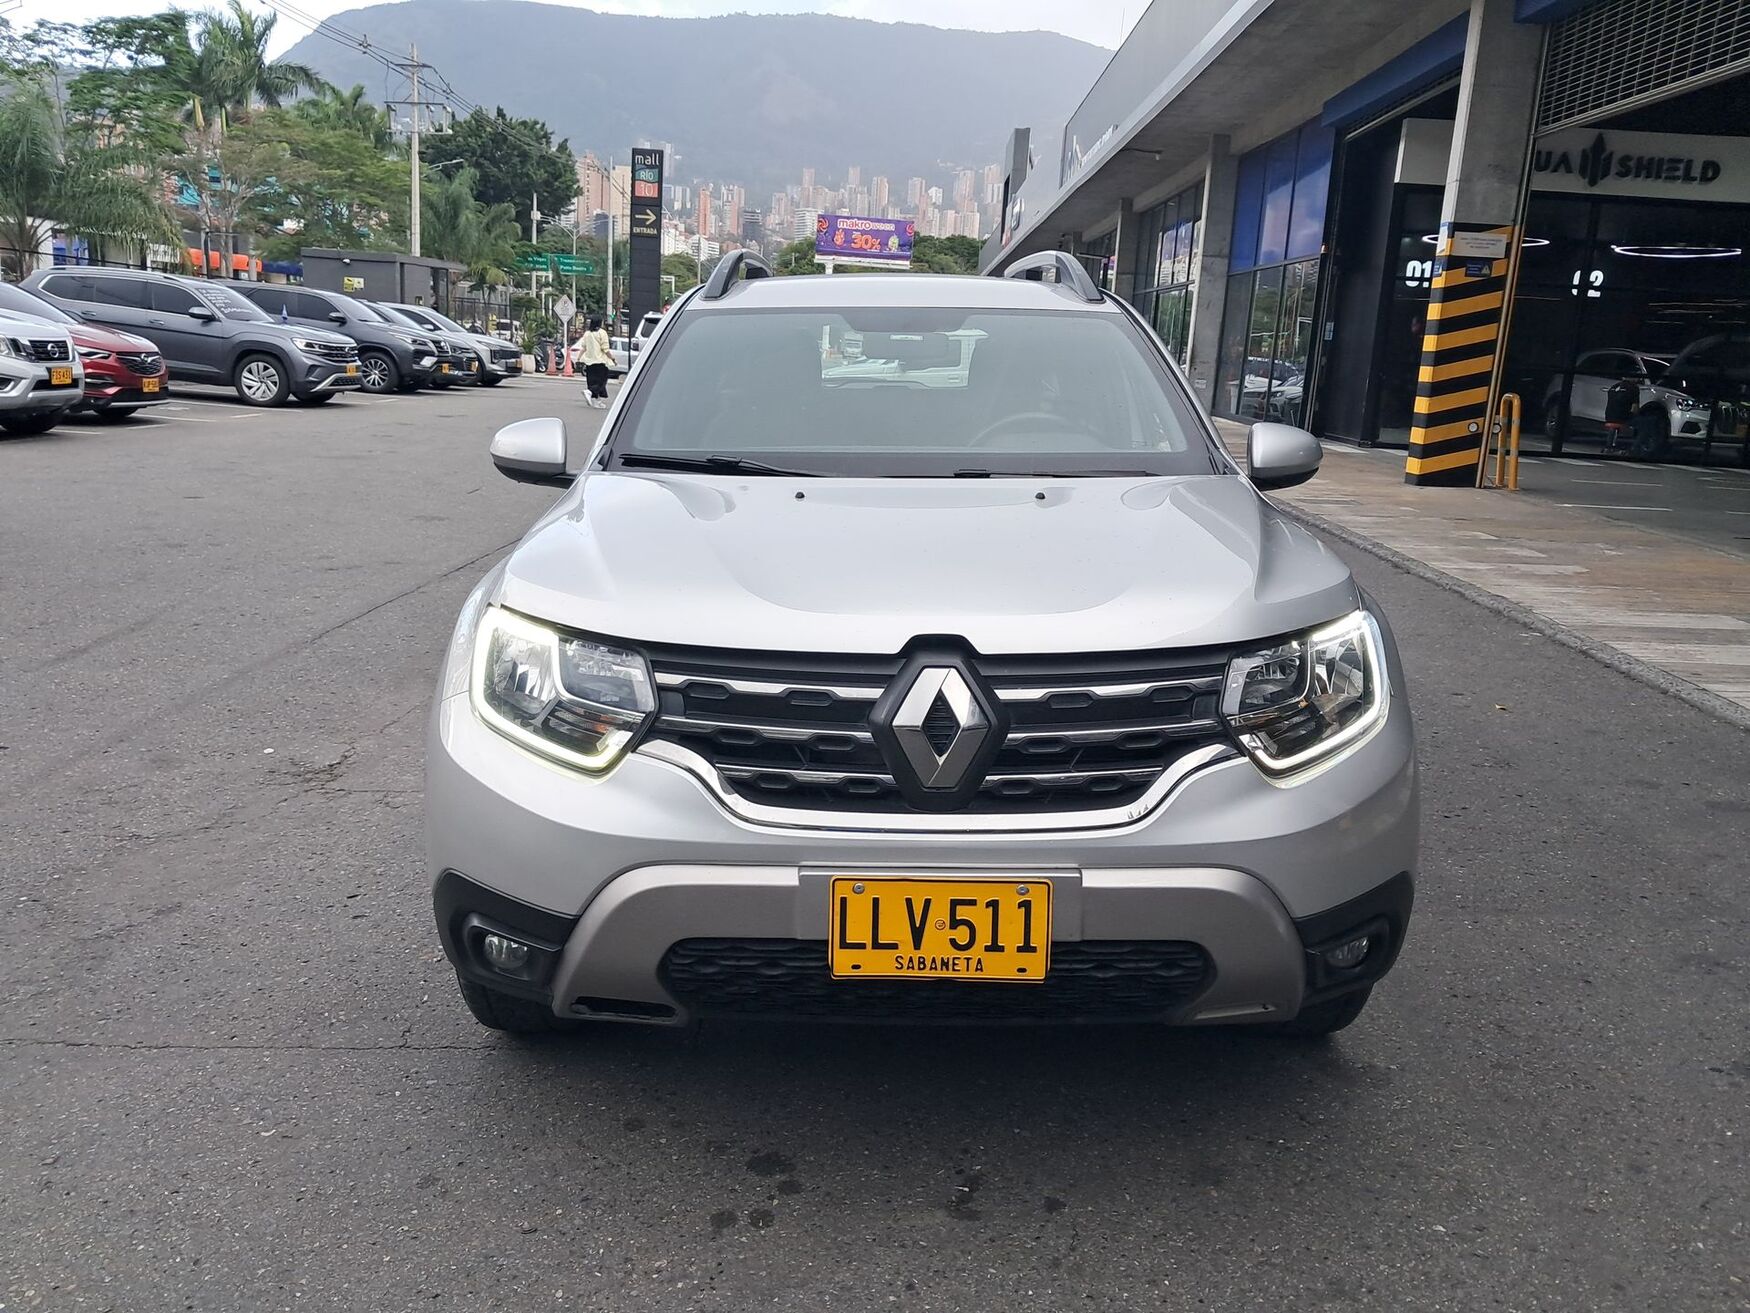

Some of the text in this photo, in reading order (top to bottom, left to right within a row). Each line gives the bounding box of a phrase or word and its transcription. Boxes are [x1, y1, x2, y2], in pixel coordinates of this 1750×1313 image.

[635, 153, 659, 166] mall
[1535, 151, 1721, 183] UA SHIELD
[639, 184, 654, 196] 10
[633, 226, 658, 235] ENTRADA
[851, 233, 881, 250] 30%
[1405, 260, 1432, 288] 01
[839, 896, 1038, 953] LLV 511
[894, 955, 984, 973] SABANETA
